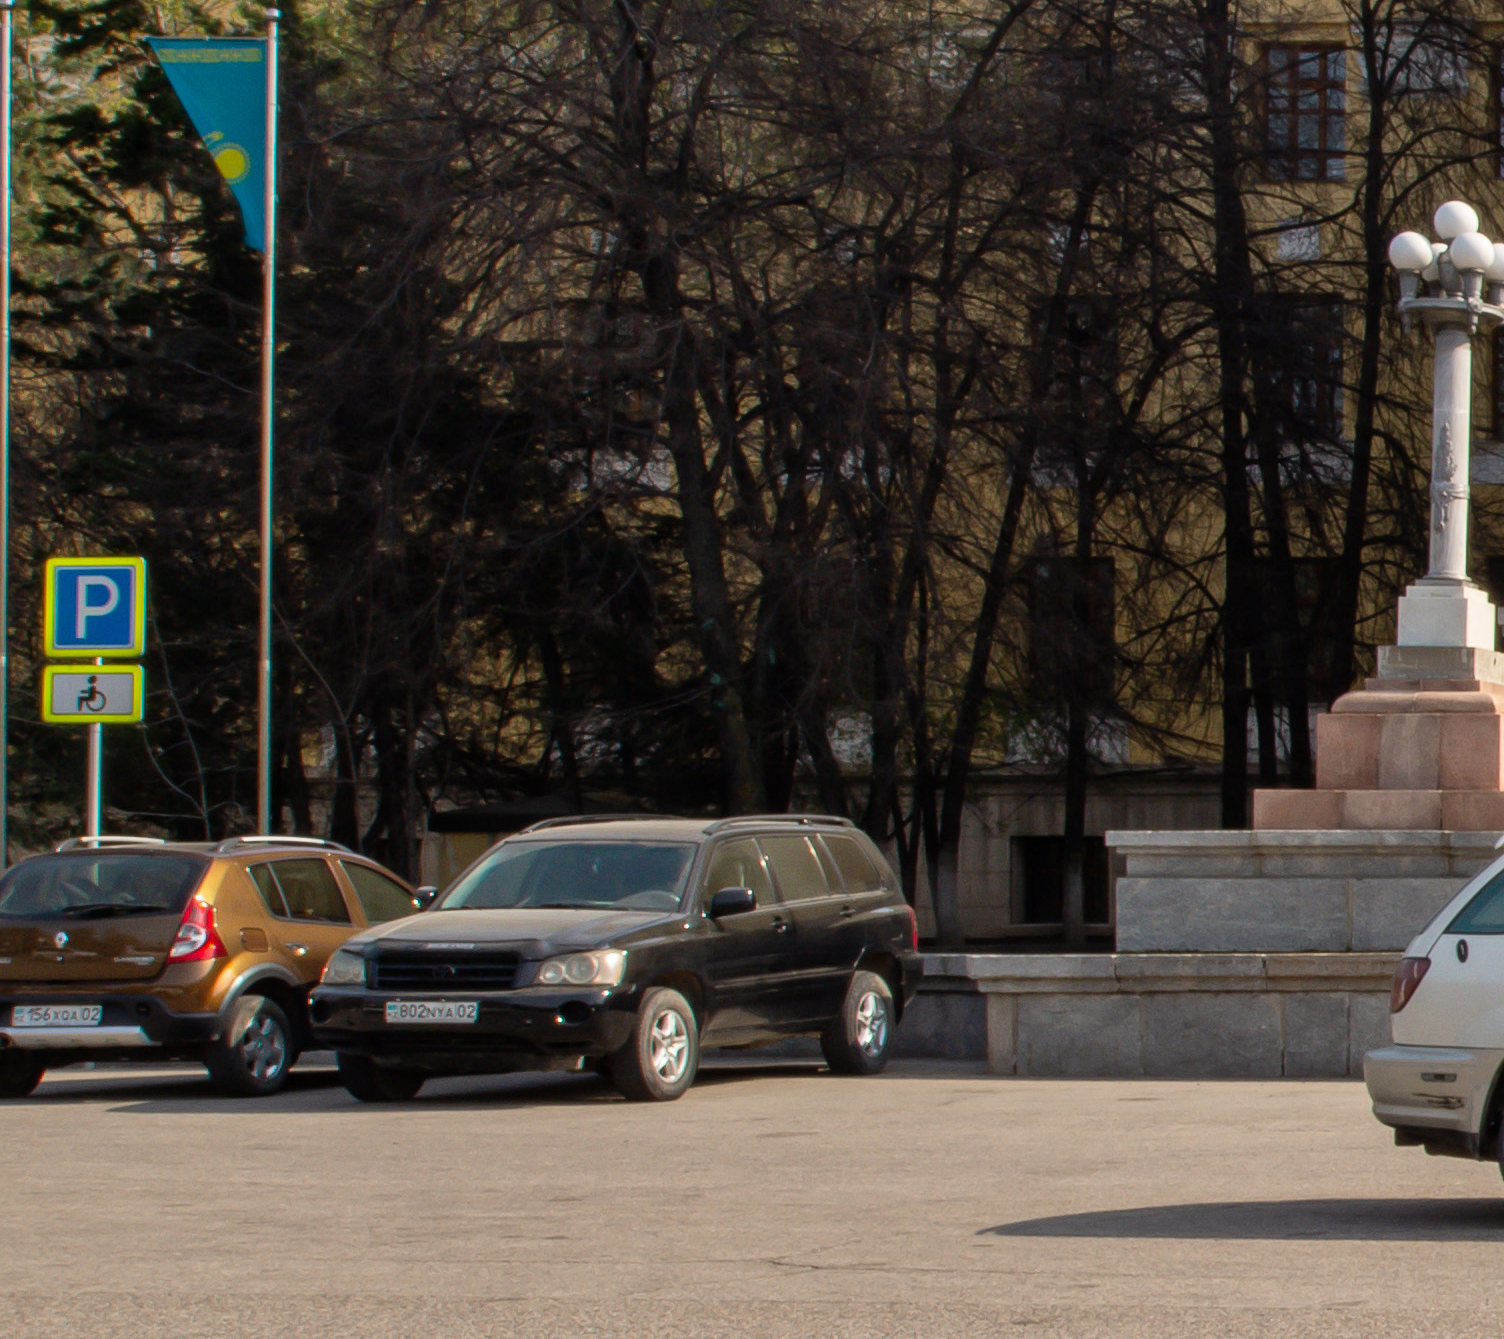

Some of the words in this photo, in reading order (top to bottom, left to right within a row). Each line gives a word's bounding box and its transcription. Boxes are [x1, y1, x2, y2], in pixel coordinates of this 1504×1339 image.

[75, 575, 120, 639] P
[81, 1007, 100, 1022] 02
[457, 1004, 476, 1018] 02
